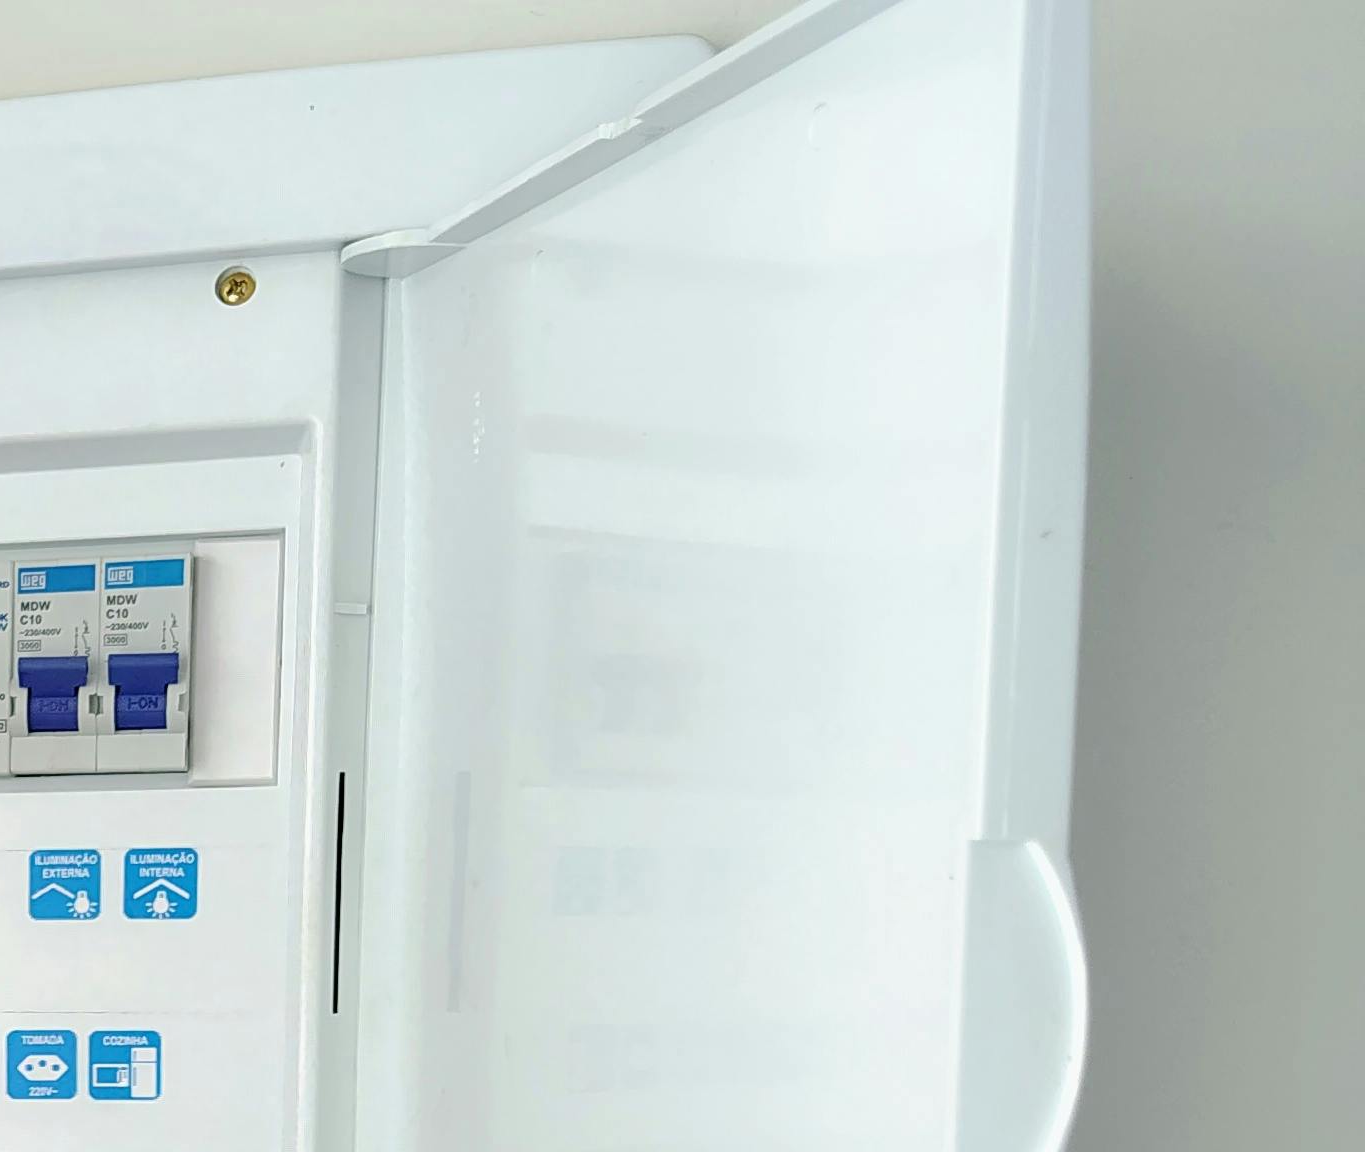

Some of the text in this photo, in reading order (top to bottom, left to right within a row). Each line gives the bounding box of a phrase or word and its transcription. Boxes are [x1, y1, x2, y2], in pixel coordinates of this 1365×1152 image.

[106, 594, 137, 605] MDW
[20, 601, 51, 612] MDW
[106, 608, 129, 619] C10
[20, 615, 42, 625] C10
[35, 853, 98, 868] ILUMINAÇÃO
[130, 852, 195, 867] ILUMINAÇÃO
[42, 868, 90, 879] EXTERNA
[139, 867, 185, 878] INTERNA
[21, 1035, 65, 1046] TOMADA
[102, 1036, 149, 1046] COZINHA
